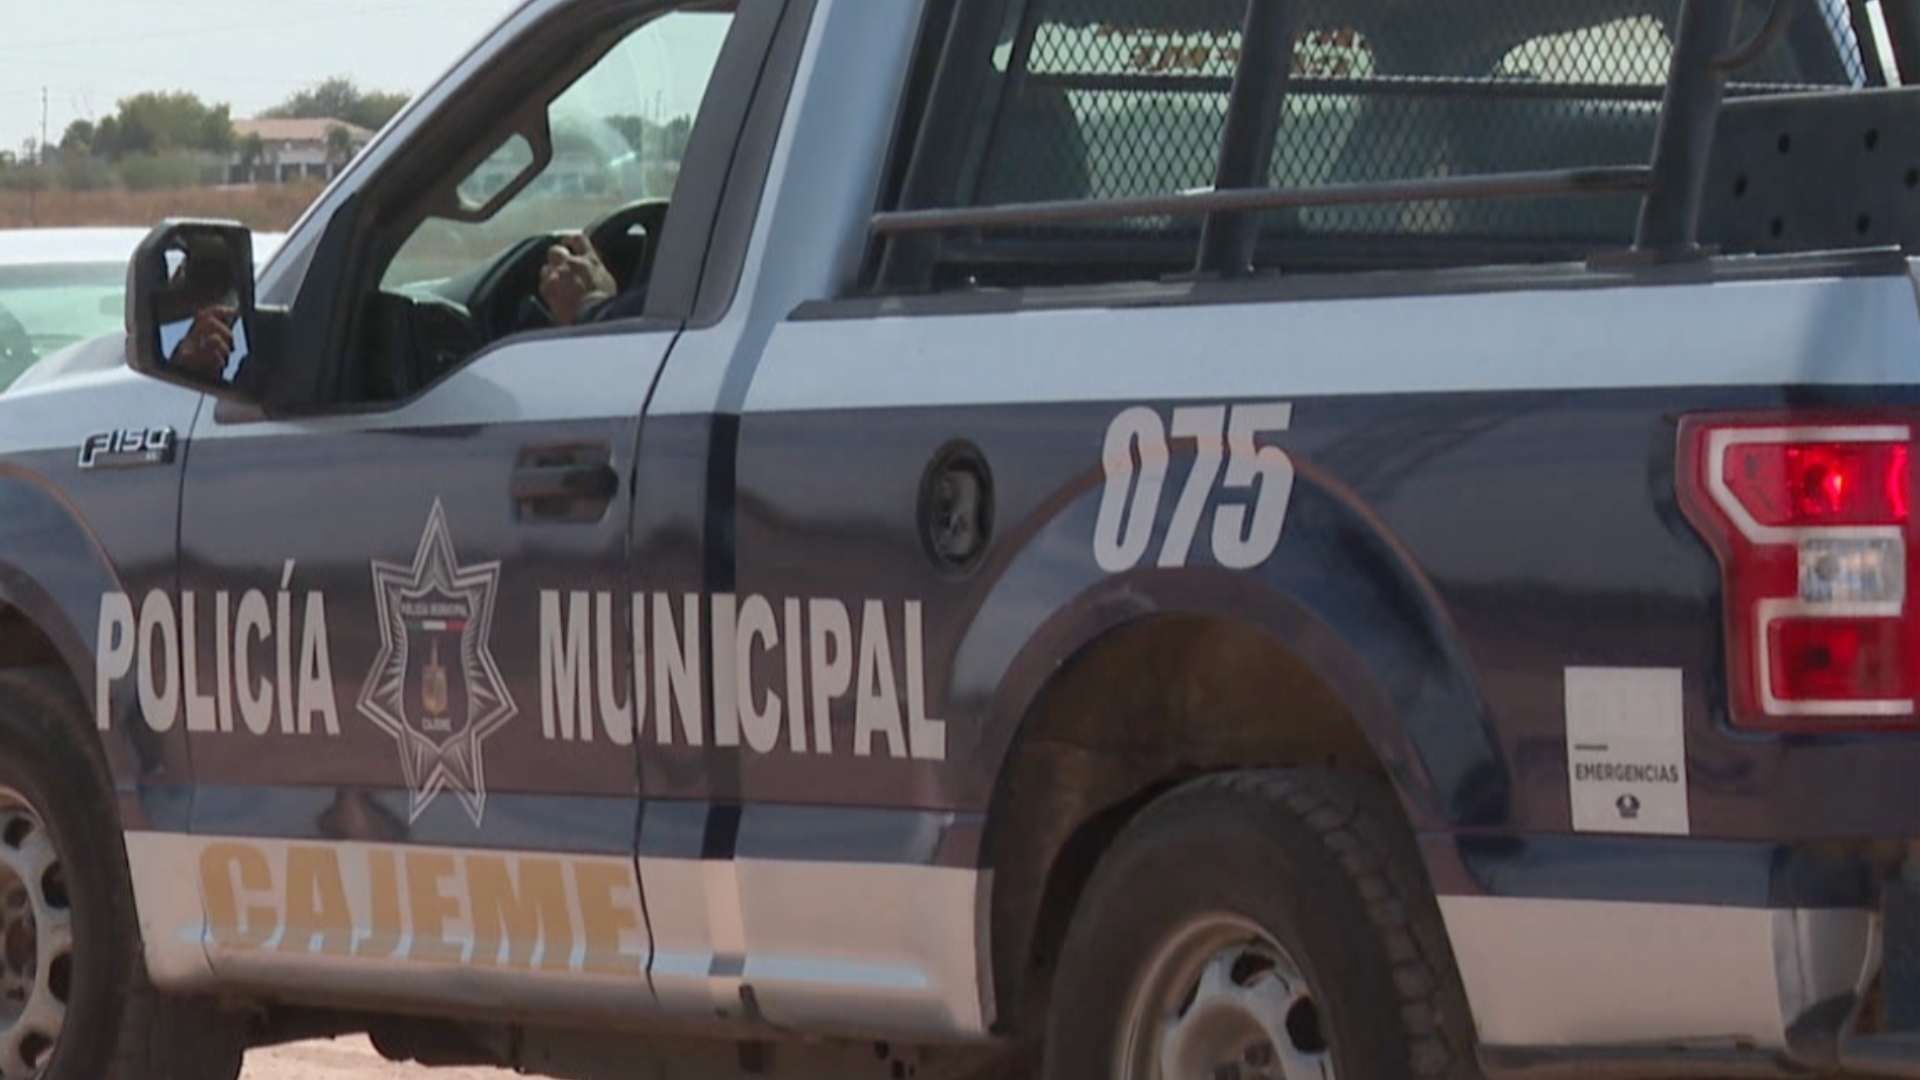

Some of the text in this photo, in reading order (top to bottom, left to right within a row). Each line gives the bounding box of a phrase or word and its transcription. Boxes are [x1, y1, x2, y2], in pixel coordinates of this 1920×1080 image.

[1093, 402, 1294, 572] 075
[96, 558, 946, 760] POLICÍA MUNICIPAL
[1574, 762, 1679, 783] EMERGENCIAS
[201, 842, 642, 976] CAJEME
